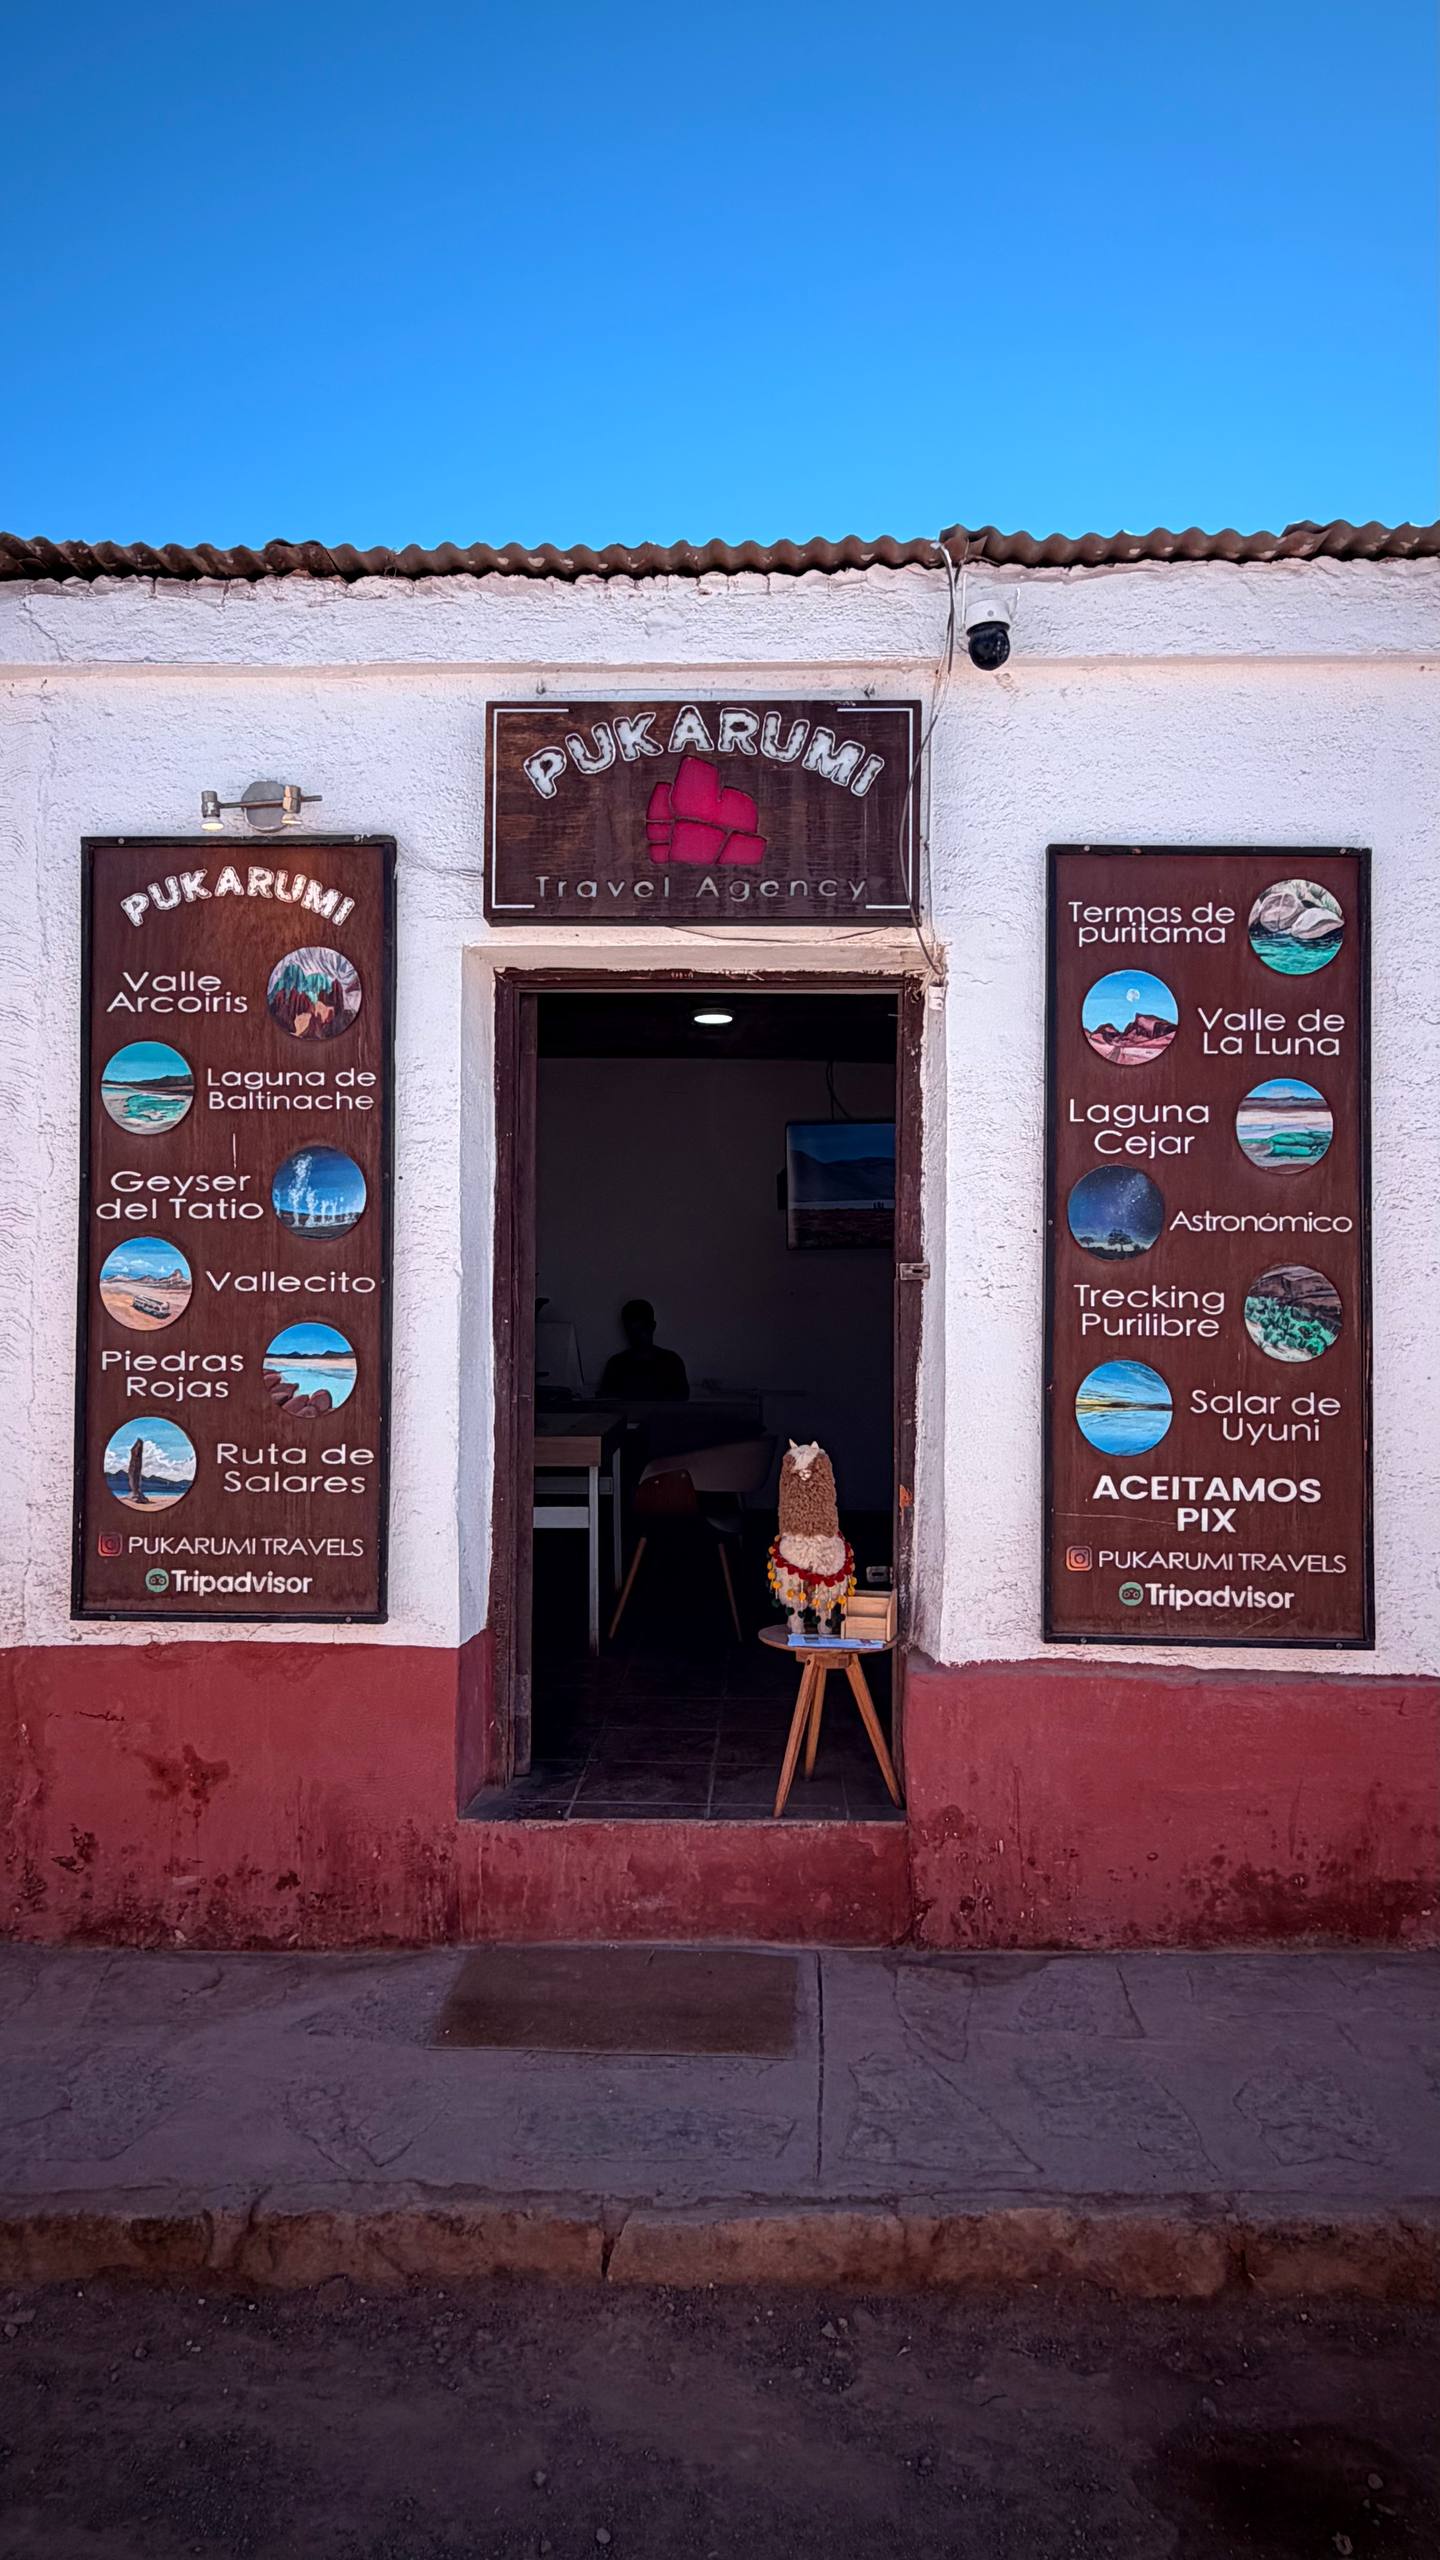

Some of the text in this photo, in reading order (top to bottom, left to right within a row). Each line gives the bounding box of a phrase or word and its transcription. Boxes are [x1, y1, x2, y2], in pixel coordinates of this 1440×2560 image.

[524, 705, 885, 799] PUKARUMI
[120, 866, 355, 927] PUKARUMI
[536, 876, 867, 902] Travel Agency
[1068, 902, 1235, 924] Termas de
[1078, 923, 1226, 947] puritama
[122, 971, 222, 992] Valle
[106, 992, 248, 1014] Arcoiris
[1198, 1007, 1345, 1032] Valle de
[1203, 1032, 1340, 1056] La Luna
[207, 1067, 376, 1091] Laguna de
[209, 1092, 375, 1110] Baltinache
[1069, 1099, 1210, 1129] Laguna
[1094, 1130, 1195, 1159] Cejar
[110, 1171, 251, 1197] Geyser
[96, 1199, 264, 1220] del Tatio
[1169, 1211, 1353, 1233] Astronómico
[205, 1271, 376, 1293] Vallecito
[1074, 1285, 1225, 1314] Trecking
[1082, 1313, 1220, 1337] Purilibre
[101, 1351, 244, 1372] Piedras
[126, 1376, 229, 1402] Rojas
[1190, 1390, 1341, 1416] Salar de
[1222, 1418, 1320, 1446] Uyuni
[216, 1443, 375, 1464] Ruta de
[223, 1471, 366, 1494] Salares
[1092, 1475, 1321, 1503] ACEITAMOS
[1177, 1508, 1236, 1533] PIX
[128, 1536, 364, 1557] PUKARUMI TRAVELS
[1098, 1551, 1346, 1573] PUKARUMI TRAVELS
[172, 1570, 312, 1596] Tripadvisor
[1145, 1583, 1294, 1611] Tripadvisor
